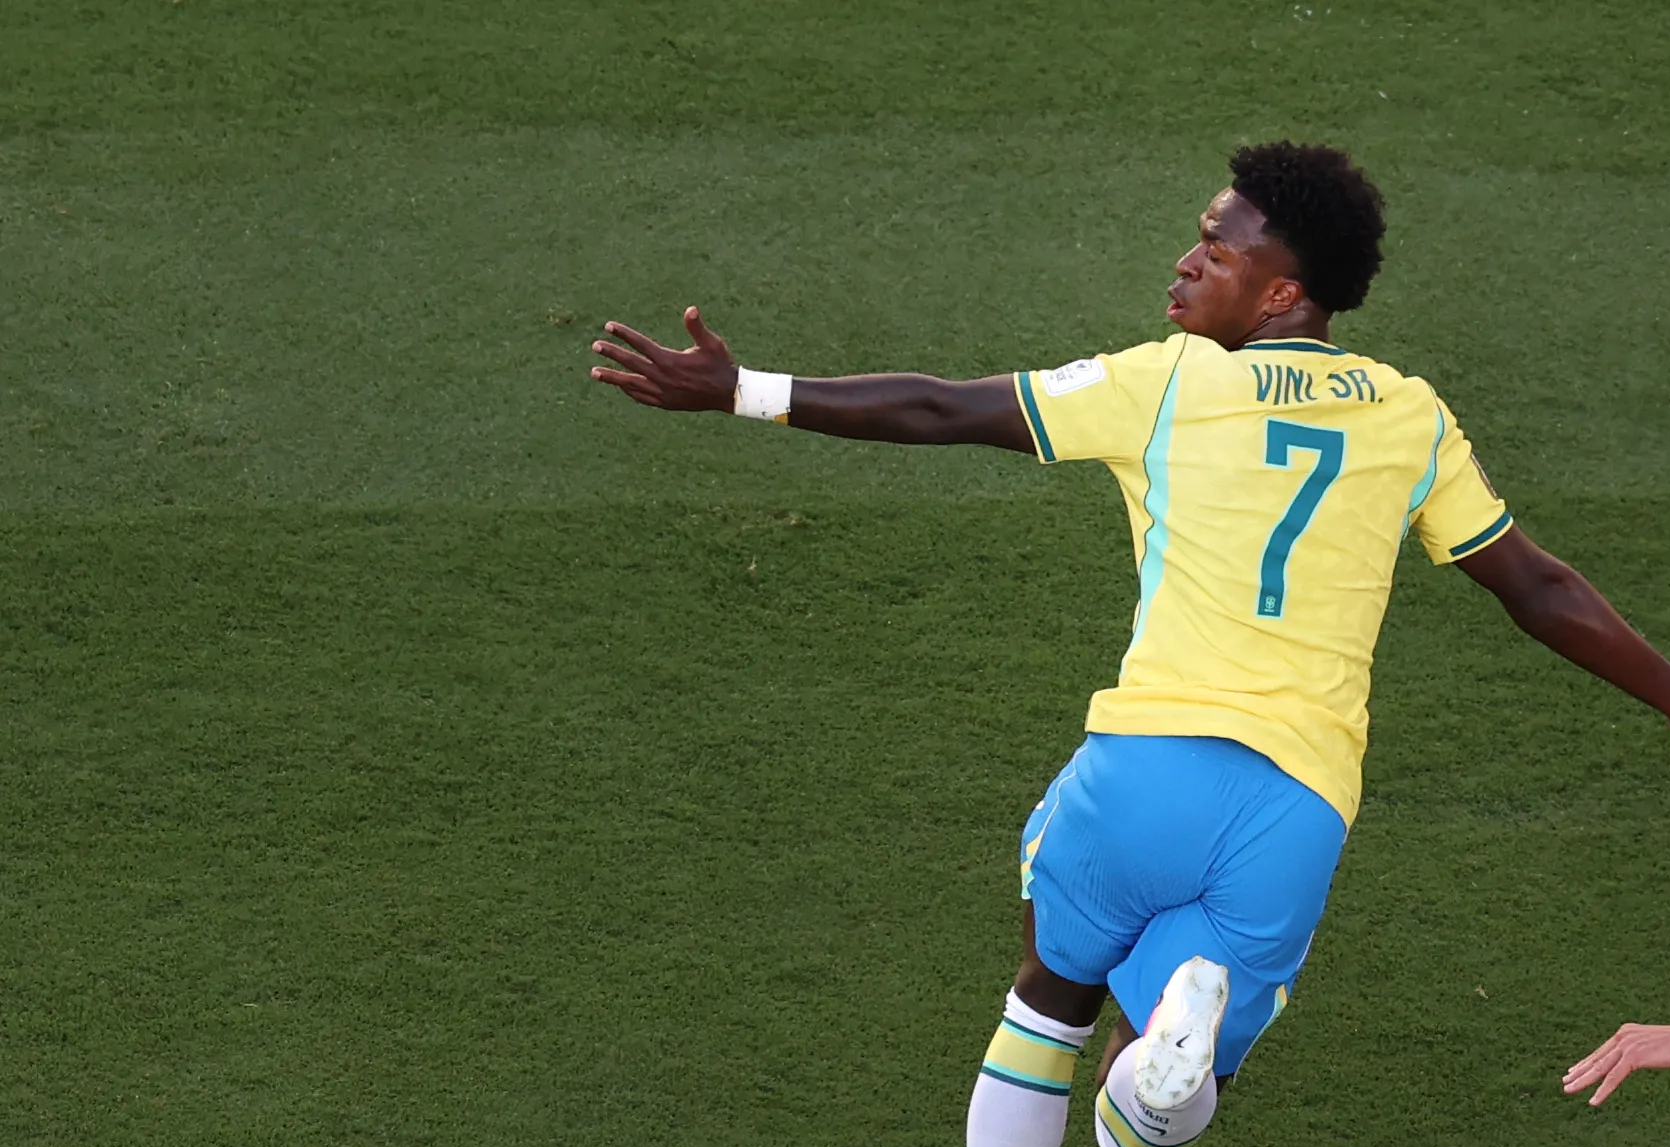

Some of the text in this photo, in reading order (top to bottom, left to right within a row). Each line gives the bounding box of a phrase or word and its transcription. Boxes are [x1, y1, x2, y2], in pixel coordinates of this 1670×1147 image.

[1250, 363, 1384, 405] VINI JR.
[1255, 416, 1347, 619] 7
